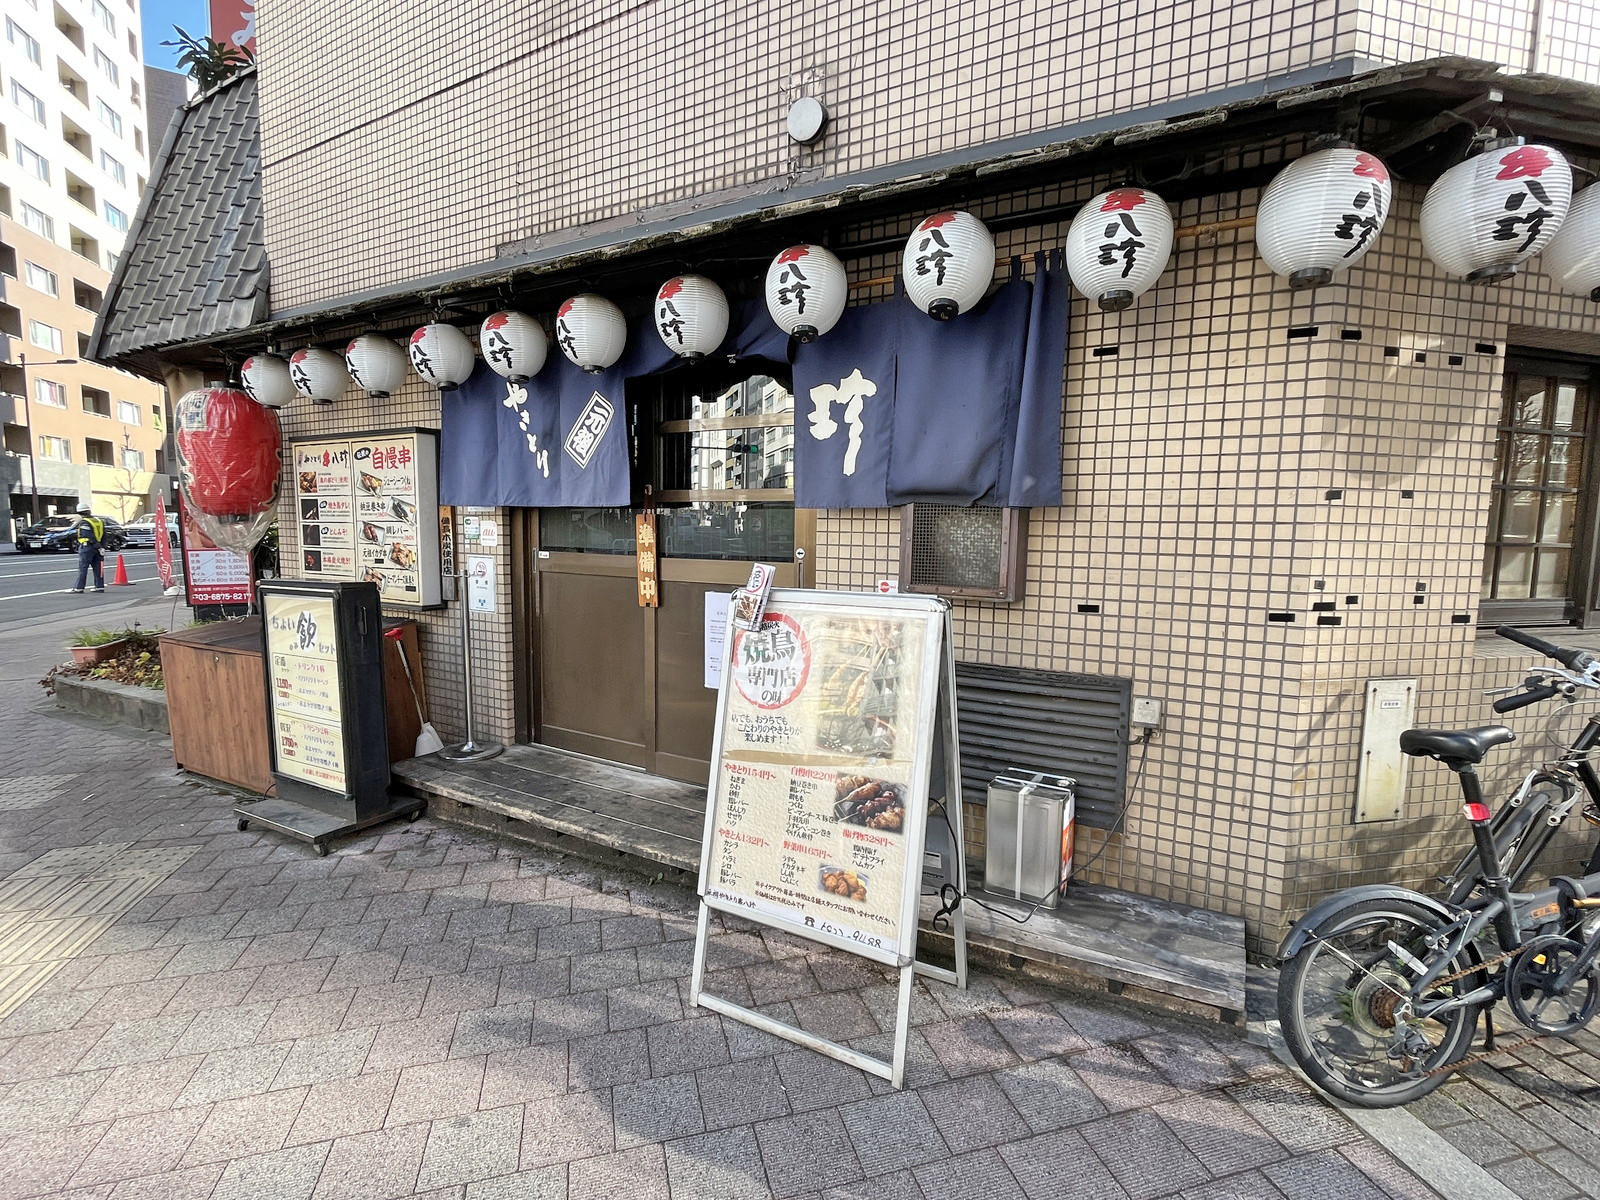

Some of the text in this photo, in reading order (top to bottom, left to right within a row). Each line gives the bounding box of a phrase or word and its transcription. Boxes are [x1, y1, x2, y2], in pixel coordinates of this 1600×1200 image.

[503, 382, 549, 478] やきとり
[372, 445, 411, 470] 自慢串
[441, 517, 453, 576] 備長木炭使用店
[638, 523, 656, 600] 準備中
[743, 628, 796, 665] 焼鳥
[747, 666, 796, 688] 専門店
[730, 775, 745, 785] ねぎま
[730, 783, 741, 791] かわ
[727, 811, 743, 821] せせり
[723, 839, 739, 849] カシラ
[722, 847, 733, 855] タン
[722, 855, 736, 864] ハラミ
[851, 860, 875, 870] ハムカツ
[779, 876, 799, 886] にんにく
